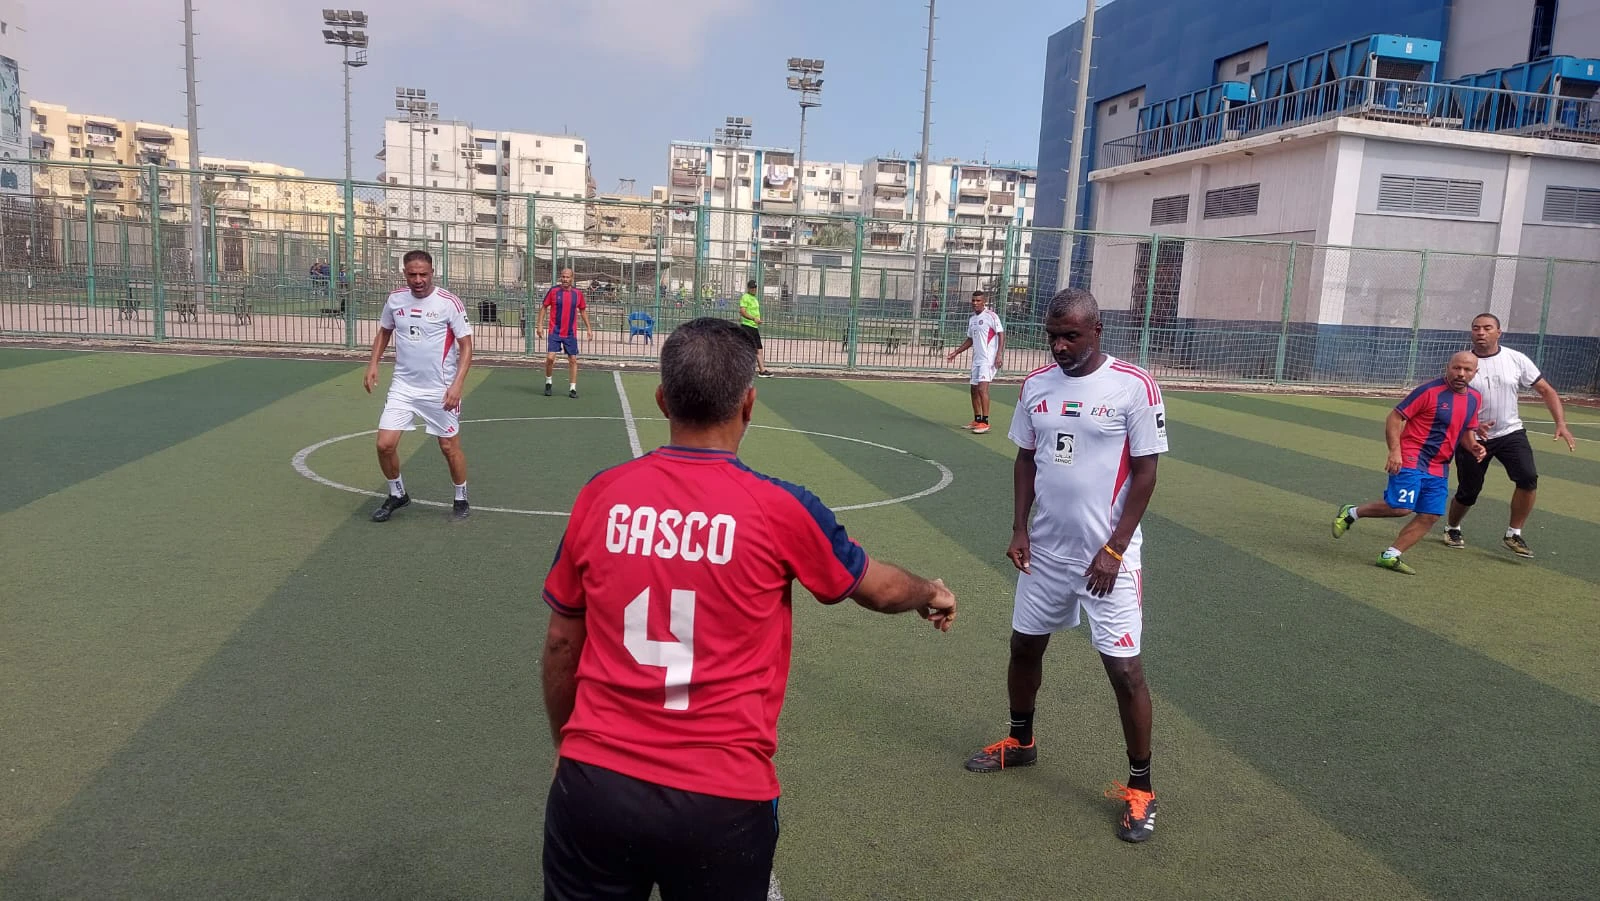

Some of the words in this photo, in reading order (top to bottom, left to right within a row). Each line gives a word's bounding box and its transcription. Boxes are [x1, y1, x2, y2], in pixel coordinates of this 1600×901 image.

[1090, 406, 1115, 418] EPC
[1398, 488, 1415, 504] 21
[605, 503, 736, 565] GASCO
[623, 585, 696, 711] 4
